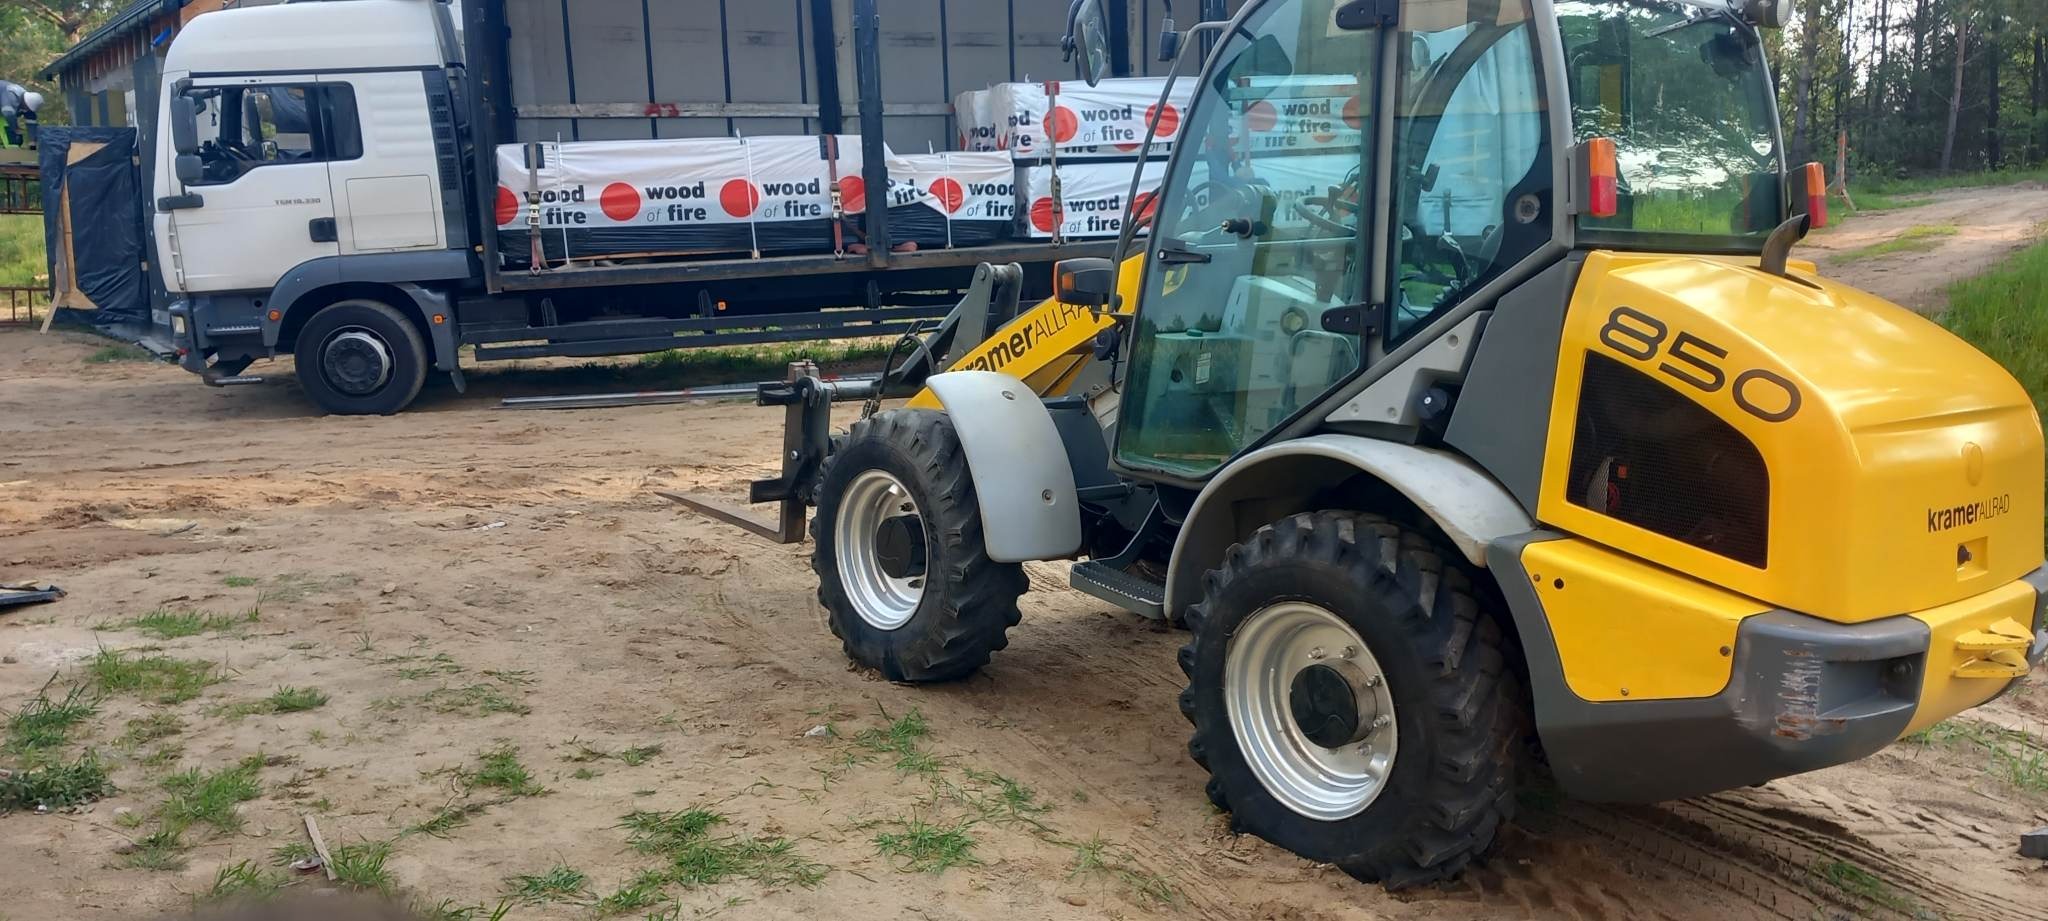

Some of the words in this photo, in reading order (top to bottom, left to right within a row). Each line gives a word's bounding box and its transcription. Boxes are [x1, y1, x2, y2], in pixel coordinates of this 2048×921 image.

[1081, 104, 1132, 122] wood
[1282, 99, 1331, 116] wood
[1084, 130, 1096, 142] of
[1101, 125, 1134, 141] fire
[1299, 119, 1331, 133] fire
[645, 181, 705, 200] wood
[763, 178, 820, 196] wood
[764, 204, 777, 218] of
[784, 201, 821, 217] fire
[967, 203, 980, 217] of
[1069, 195, 1119, 212] wood
[546, 208, 586, 224] fire
[646, 209, 662, 222] of
[667, 204, 706, 221] fire
[1069, 219, 1081, 233] of
[1087, 215, 1120, 232] fire
[1600, 306, 1802, 423] 850
[1927, 493, 2010, 533] kramerALLRAD
